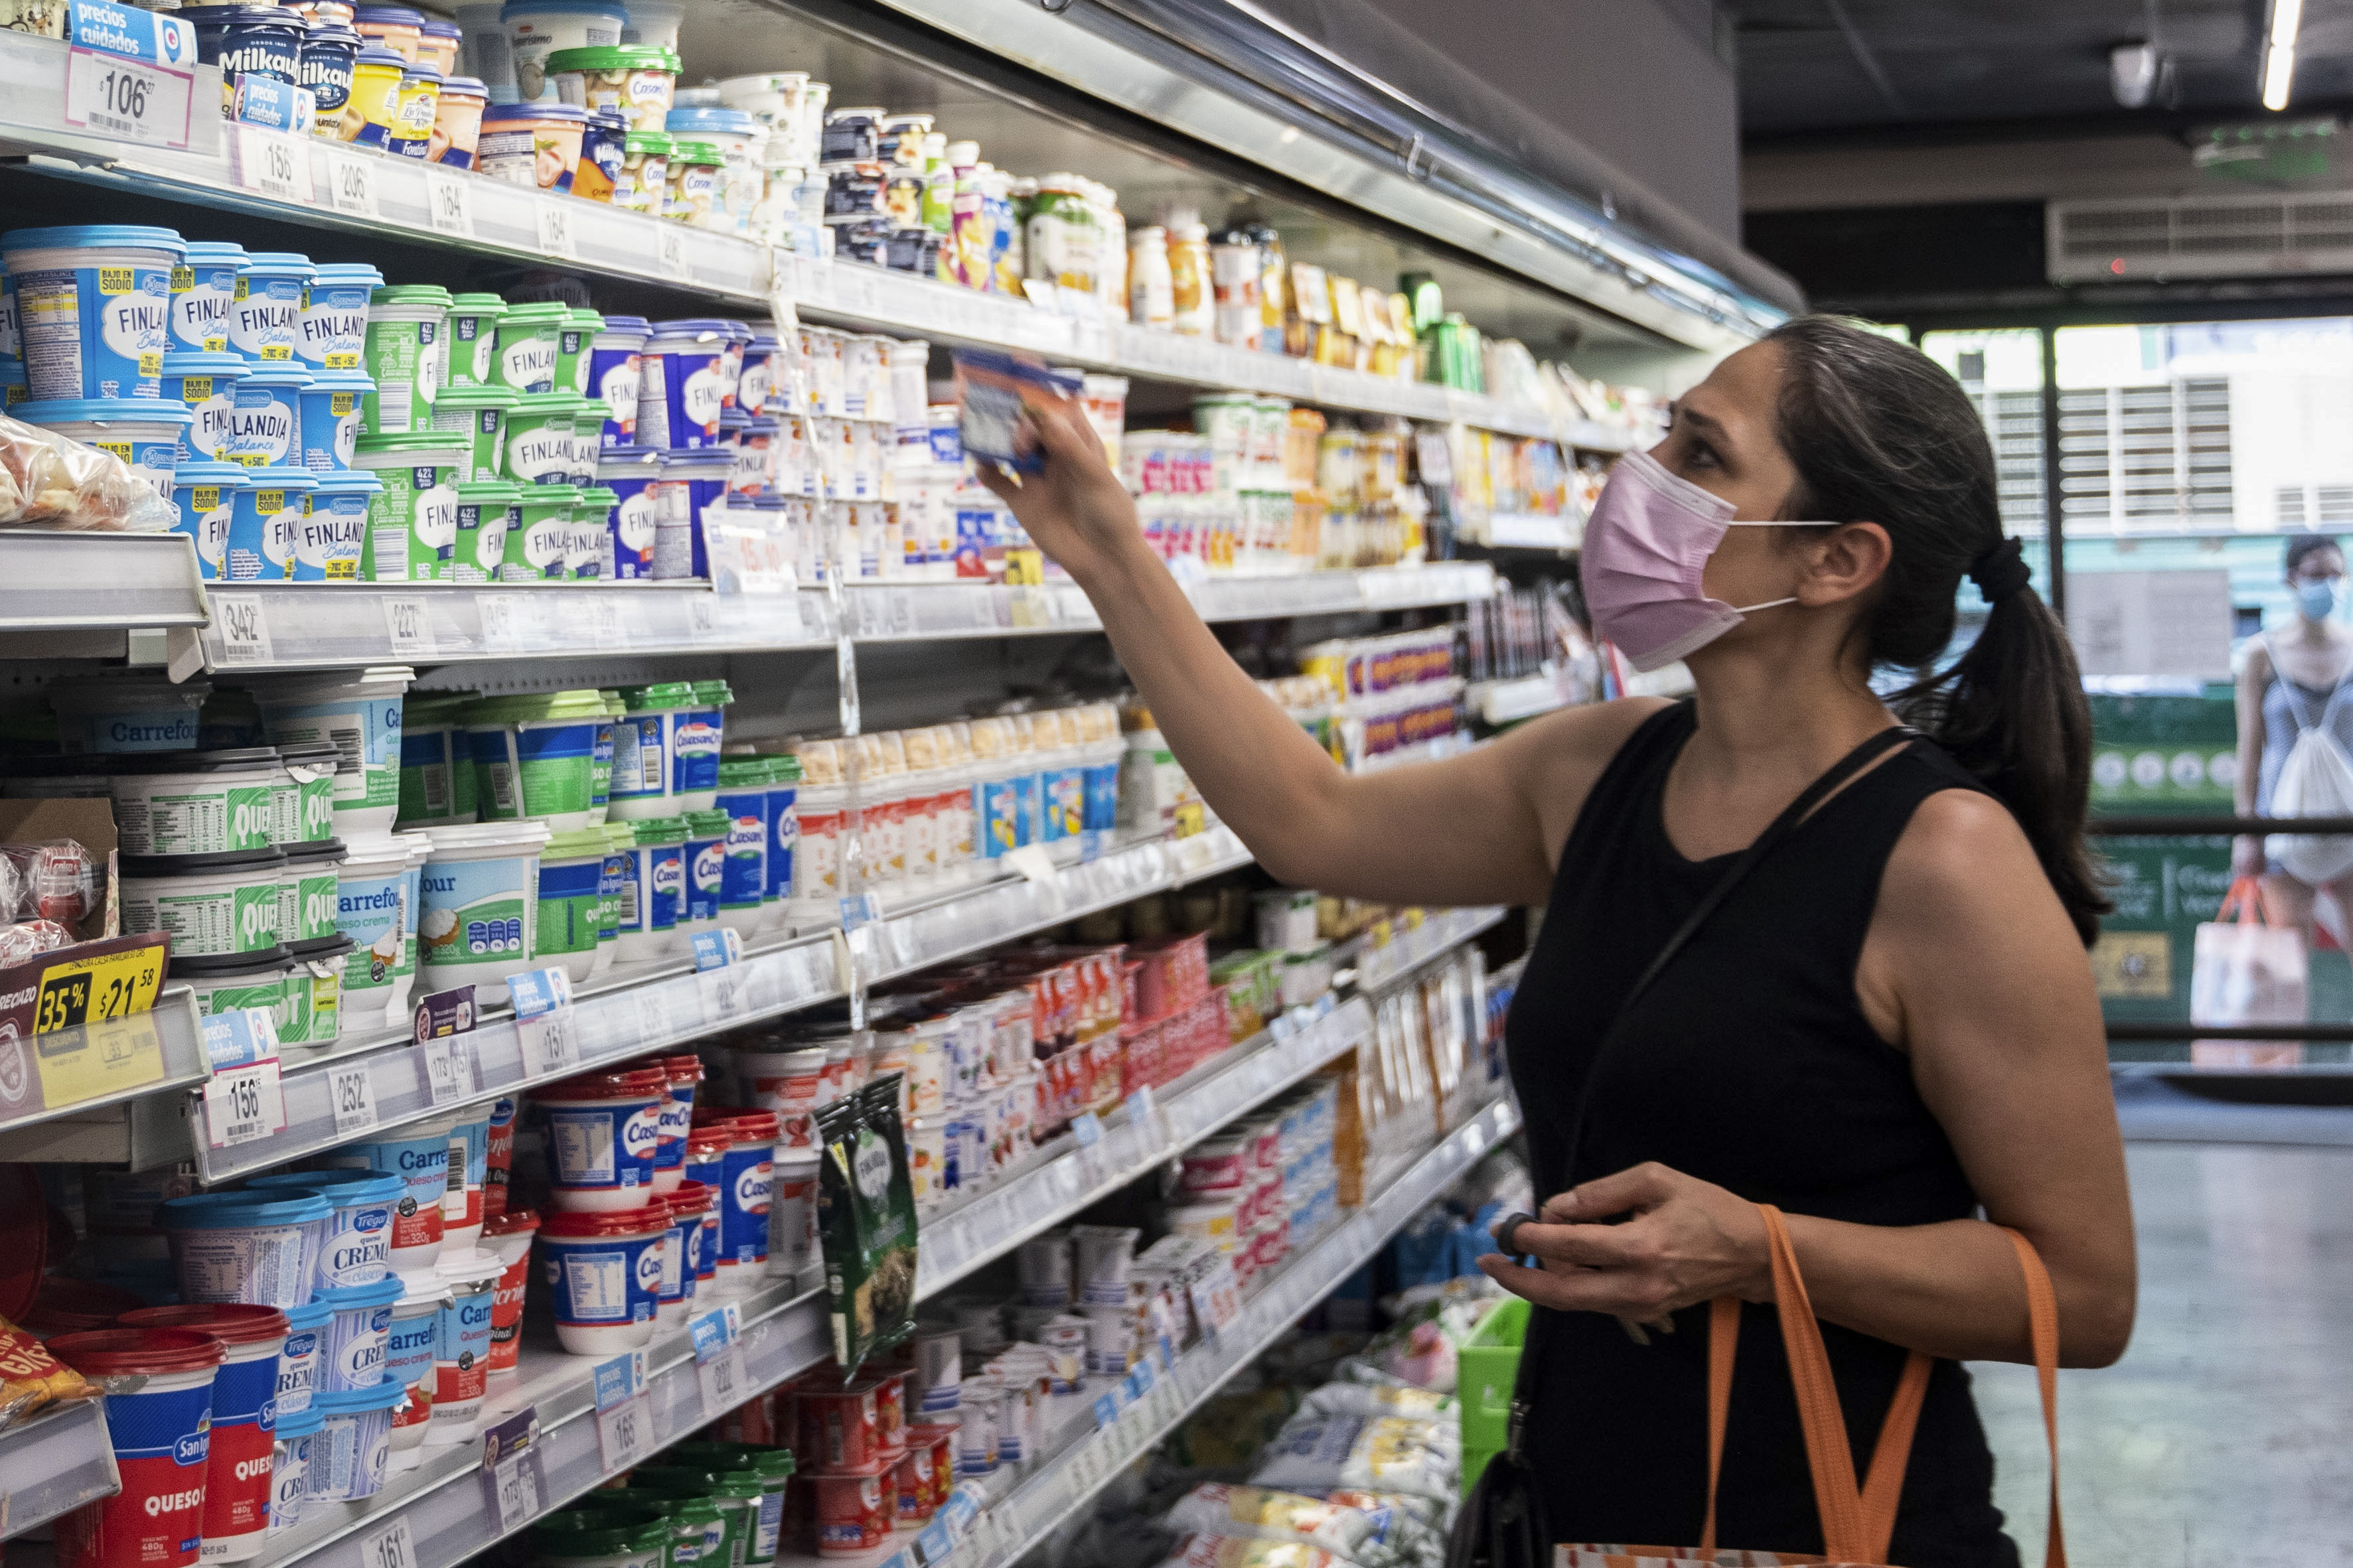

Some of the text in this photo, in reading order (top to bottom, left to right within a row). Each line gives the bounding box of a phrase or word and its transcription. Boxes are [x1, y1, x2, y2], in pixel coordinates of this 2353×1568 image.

[78, 3, 127, 29] precios
[81, 26, 139, 54] cuidados
[106, 71, 146, 119] 106
[250, 83, 279, 104] precios
[440, 186, 463, 218] 164
[103, 279, 131, 290] SODIO
[102, 387, 118, 397] 290g
[186, 389, 210, 398] SODIO
[417, 468, 432, 479] 42%
[194, 499, 216, 508] SODIO
[259, 502, 281, 511] SODIO
[461, 508, 476, 519] 42%
[226, 604, 258, 642] 342
[106, 976, 135, 1025] 21
[140, 968, 154, 987] 58
[232, 1079, 258, 1120] 156
[338, 1072, 366, 1113] 252
[357, 1212, 387, 1229] Tregar
[360, 1236, 381, 1244] queso
[411, 1232, 430, 1244] 320g
[290, 1360, 310, 1371] queso
[181, 1440, 198, 1457] San
[145, 1488, 200, 1517] QUESO
[141, 1542, 163, 1551] 480g
